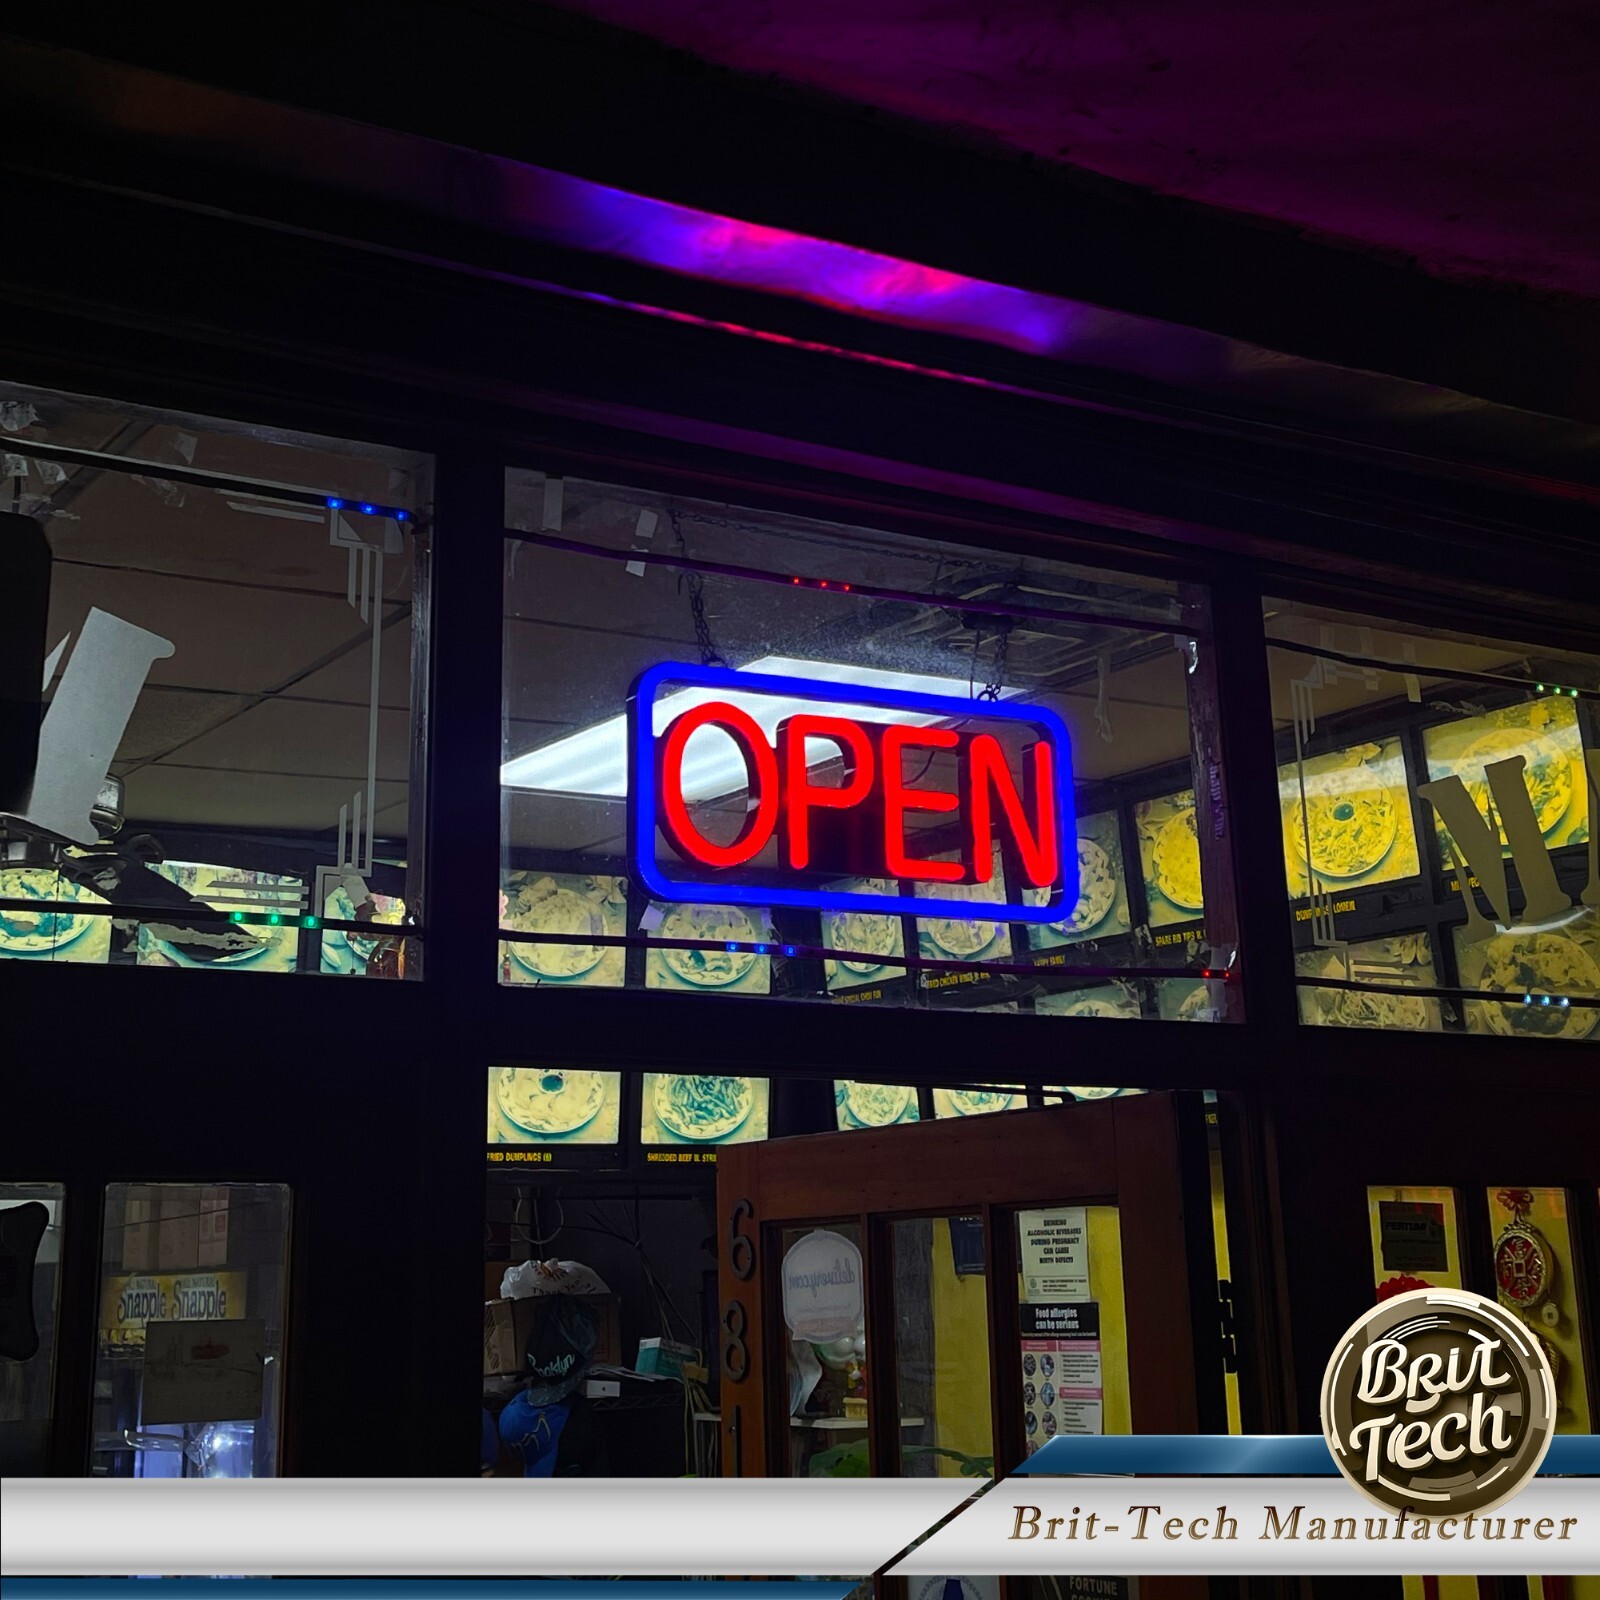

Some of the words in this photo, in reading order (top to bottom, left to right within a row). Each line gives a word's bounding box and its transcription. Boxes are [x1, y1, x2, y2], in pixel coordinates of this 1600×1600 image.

[662, 702, 1058, 887] OPEN
[505, 1152, 542, 1162] DUMPLINGS
[647, 1152, 678, 1162] SHREDDED
[678, 1153, 693, 1162] BEEF
[117, 1282, 167, 1328] Snapple
[171, 1279, 226, 1321] Snapple
[1035, 1308, 1050, 1318] Food
[1050, 1307, 1078, 1319] allergies
[1035, 1321, 1047, 1330] can
[1046, 1320, 1055, 1330] be
[1055, 1319, 1079, 1330] serious
